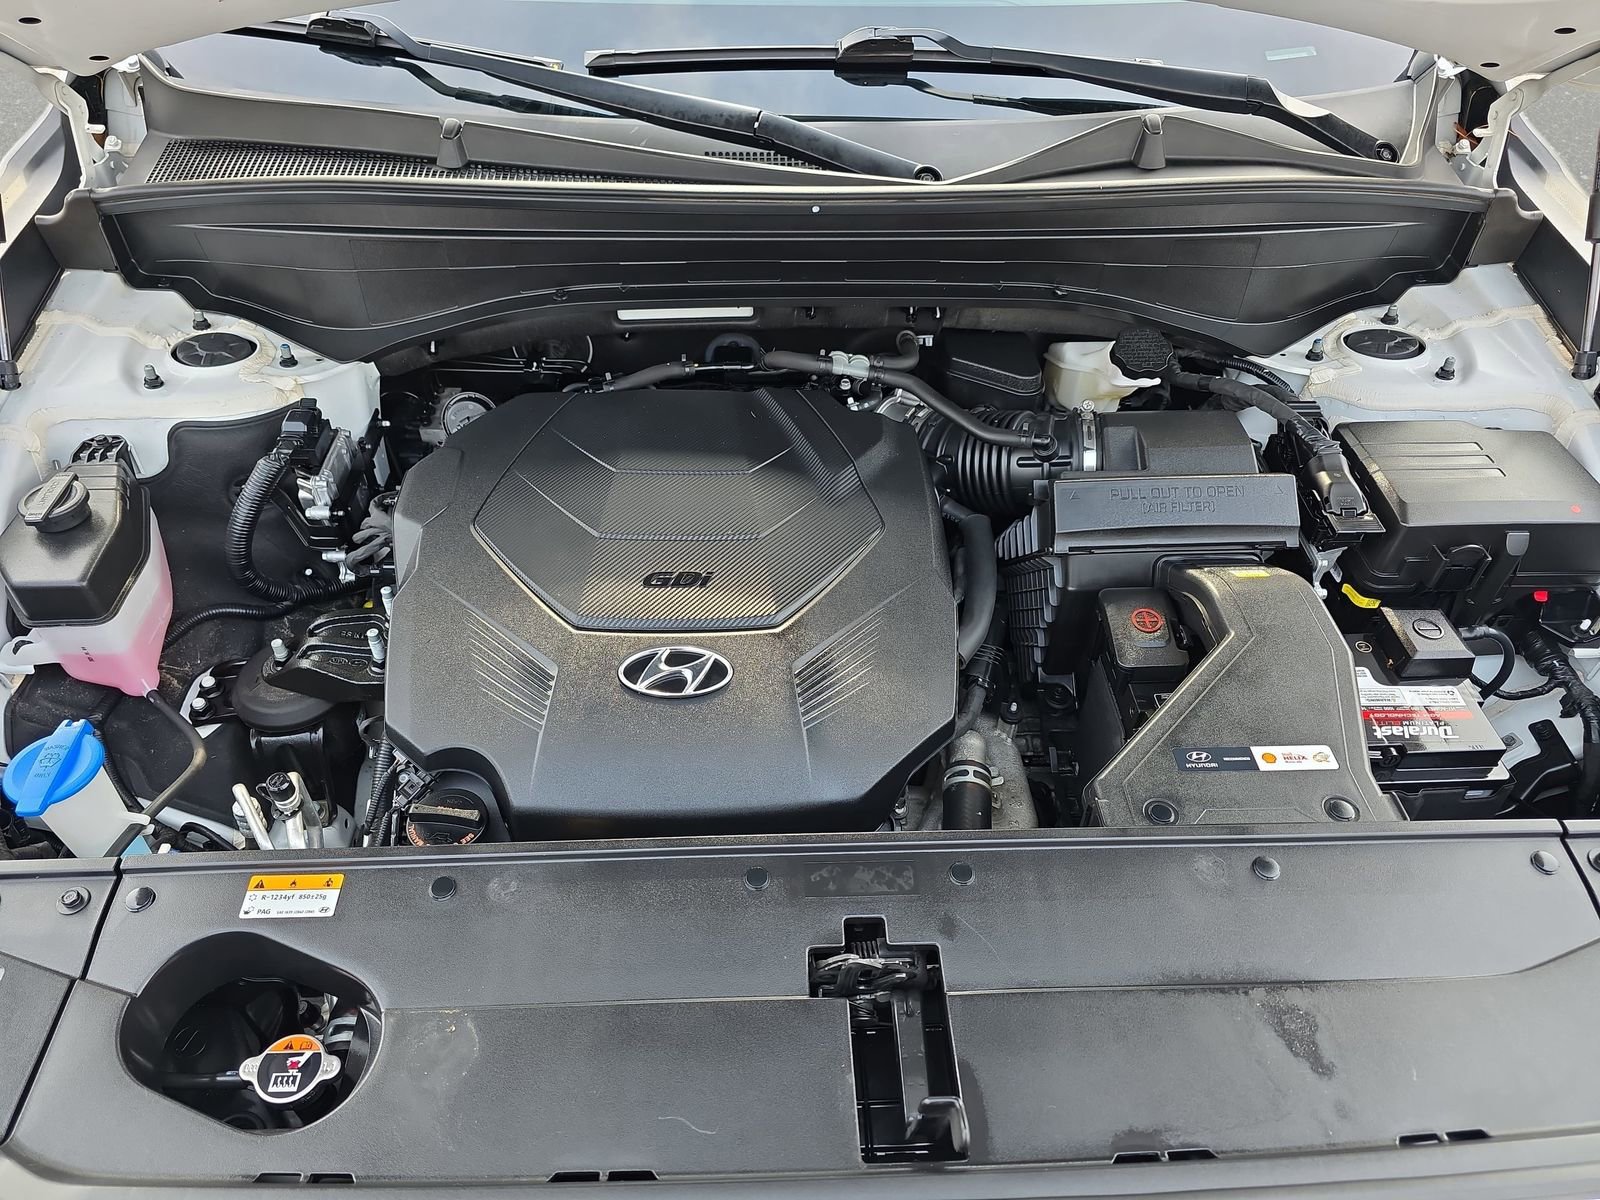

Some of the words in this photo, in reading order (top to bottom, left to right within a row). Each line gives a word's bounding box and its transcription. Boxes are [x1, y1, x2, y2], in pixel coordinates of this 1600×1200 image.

[1110, 488, 1147, 501] PULL
[1150, 487, 1181, 500] OUT
[1184, 486, 1202, 499] TO
[1206, 485, 1246, 498] OPEN
[641, 571, 716, 588] GDi
[1373, 725, 1459, 739] Duralast
[261, 893, 295, 901] R-1234yf
